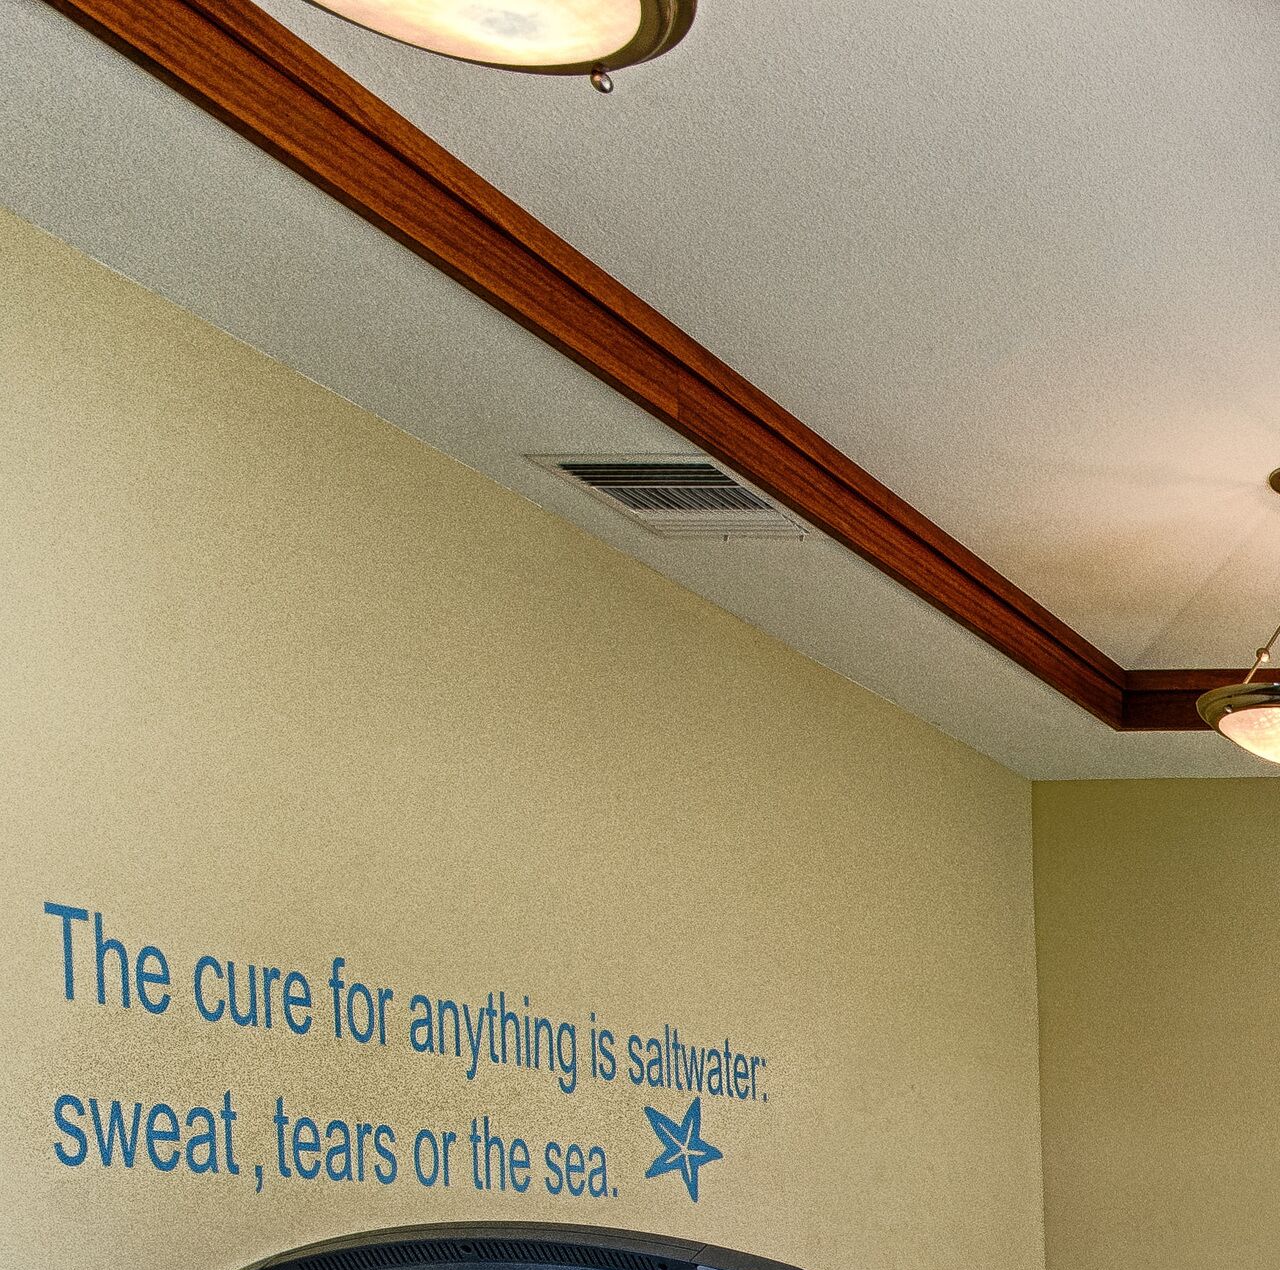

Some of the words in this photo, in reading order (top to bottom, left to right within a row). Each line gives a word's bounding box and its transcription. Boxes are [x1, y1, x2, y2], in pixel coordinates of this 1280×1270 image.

[44, 902, 171, 1014] The
[194, 955, 312, 1034] cure
[328, 957, 394, 1045] for
[409, 992, 577, 1094] anything
[590, 1012, 616, 1081] is
[413, 1129, 457, 1187] or
[469, 1117, 531, 1193] the
[544, 1142, 619, 1198] sea.
